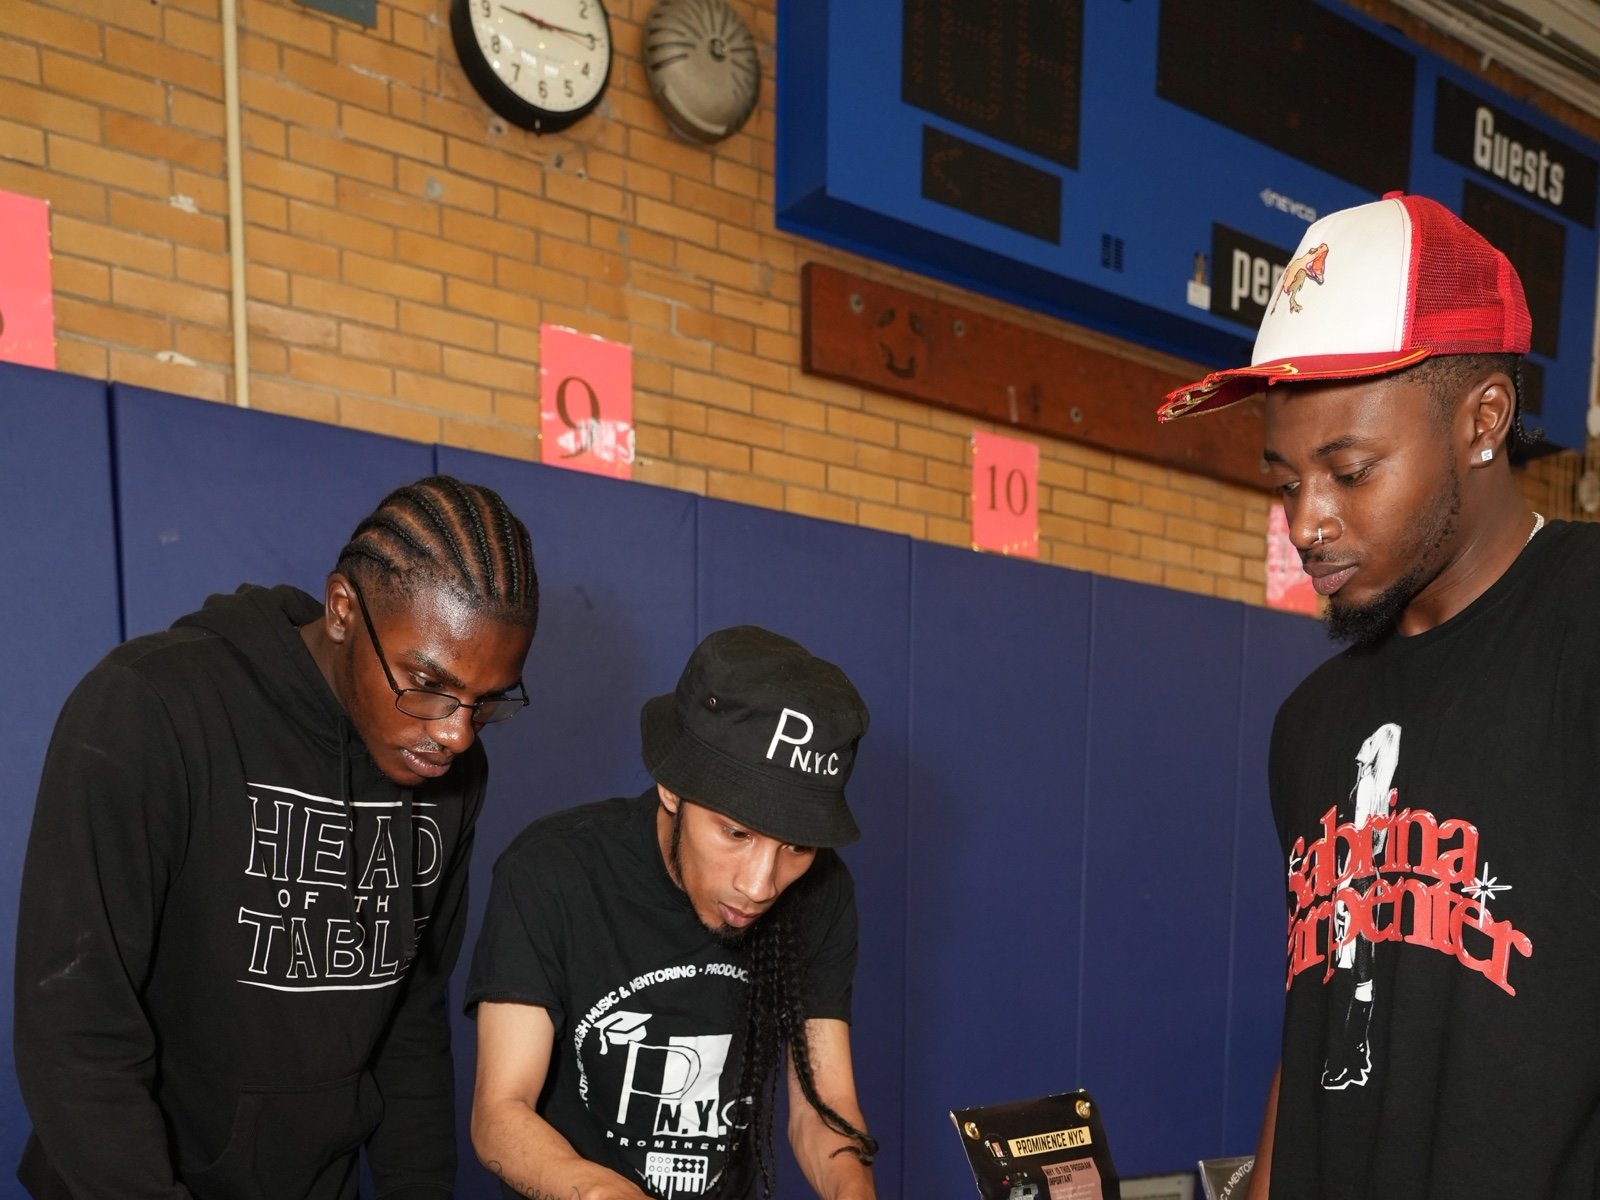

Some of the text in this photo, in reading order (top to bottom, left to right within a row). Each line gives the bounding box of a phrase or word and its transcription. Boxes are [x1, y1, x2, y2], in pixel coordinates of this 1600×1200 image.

[1474, 106, 1565, 206] Guests
[556, 376, 601, 459] 9
[987, 464, 1028, 516] 10
[244, 796, 442, 889] HEAD
[278, 888, 389, 913] OF TH
[238, 906, 429, 978] TABL
[585, 991, 620, 1024] MUSIC
[618, 985, 631, 999] &
[629, 964, 697, 993] MENTORING
[606, 1130, 740, 1152] PROMINENC
[1016, 1129, 1085, 1155] PROMINENCE NYC
[1060, 1165, 1071, 1175] THIS
[1070, 1161, 1092, 1171] PROGRAM
